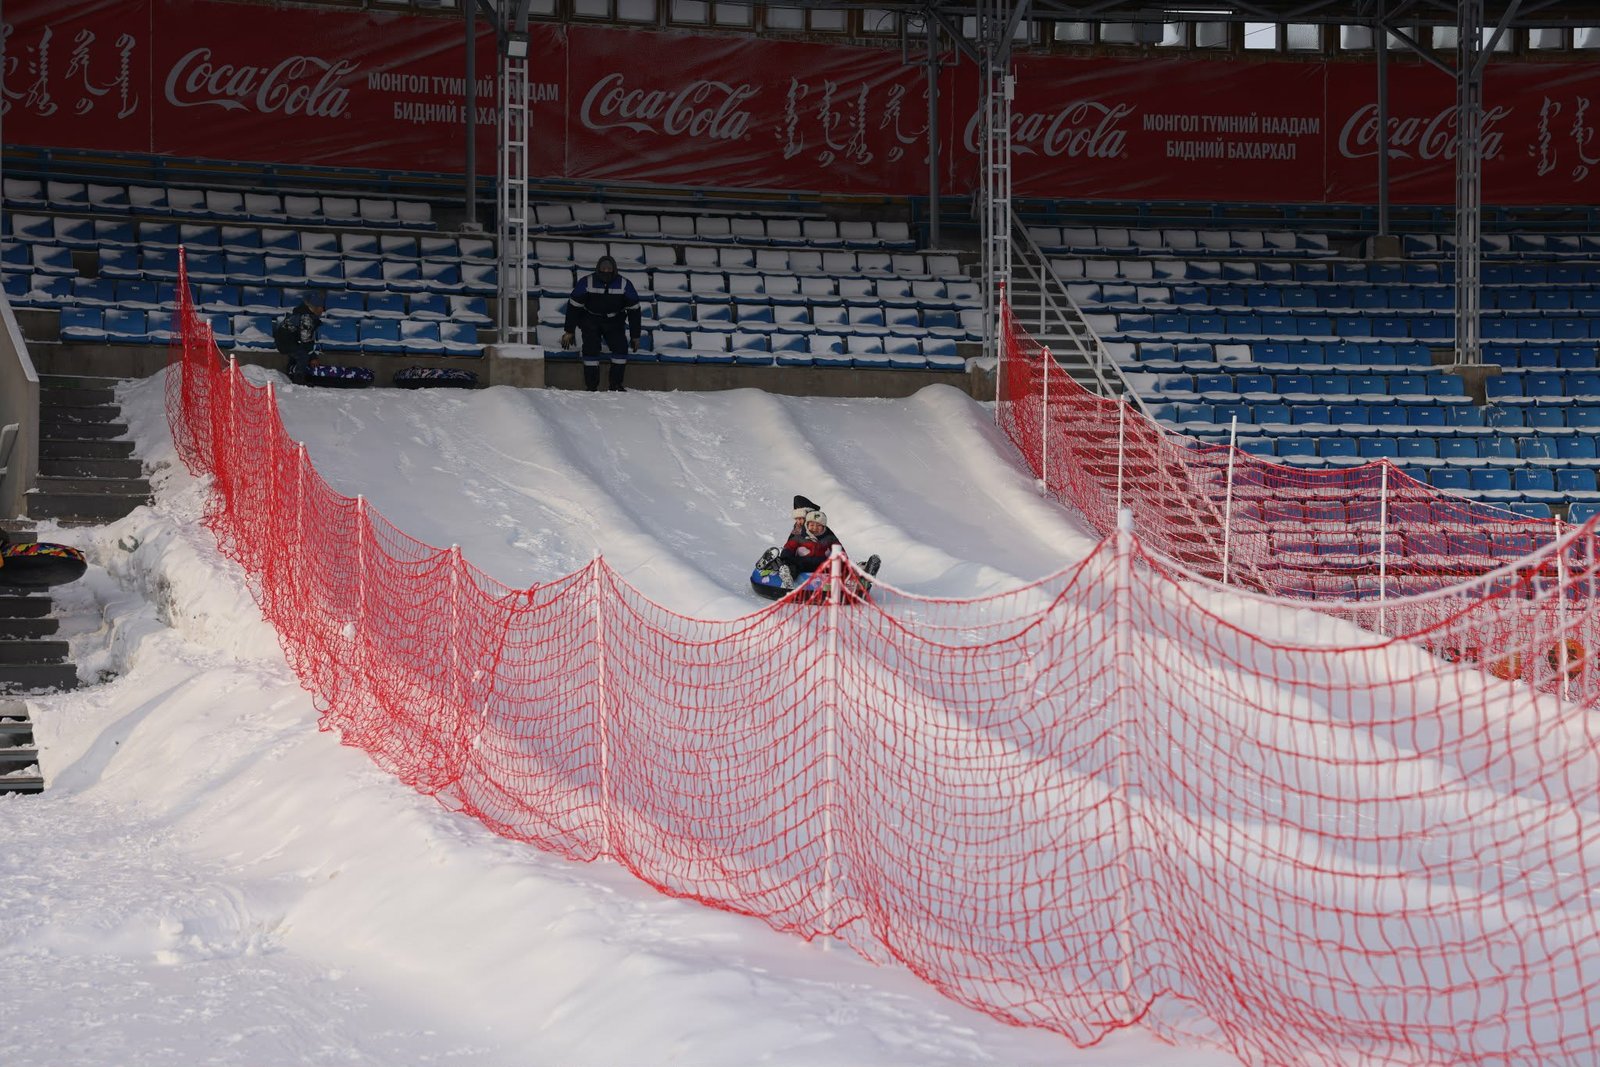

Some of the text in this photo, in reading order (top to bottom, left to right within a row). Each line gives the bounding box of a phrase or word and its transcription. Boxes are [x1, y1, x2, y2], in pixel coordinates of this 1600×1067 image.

[165, 47, 361, 119] Coca-Cola
[368, 72, 559, 103] МОНГОЛ ТҮМИЙ АДАМ
[394, 100, 457, 125] БИДНИЙ
[580, 72, 763, 141] Coca-Cola
[963, 101, 1138, 158] Cca-Cola
[1143, 112, 1320, 137] МОНГОЛ ТҮМНИЙ НААДАМ
[1166, 136, 1296, 162] БИДНИЙ БАХАРХАЛ
